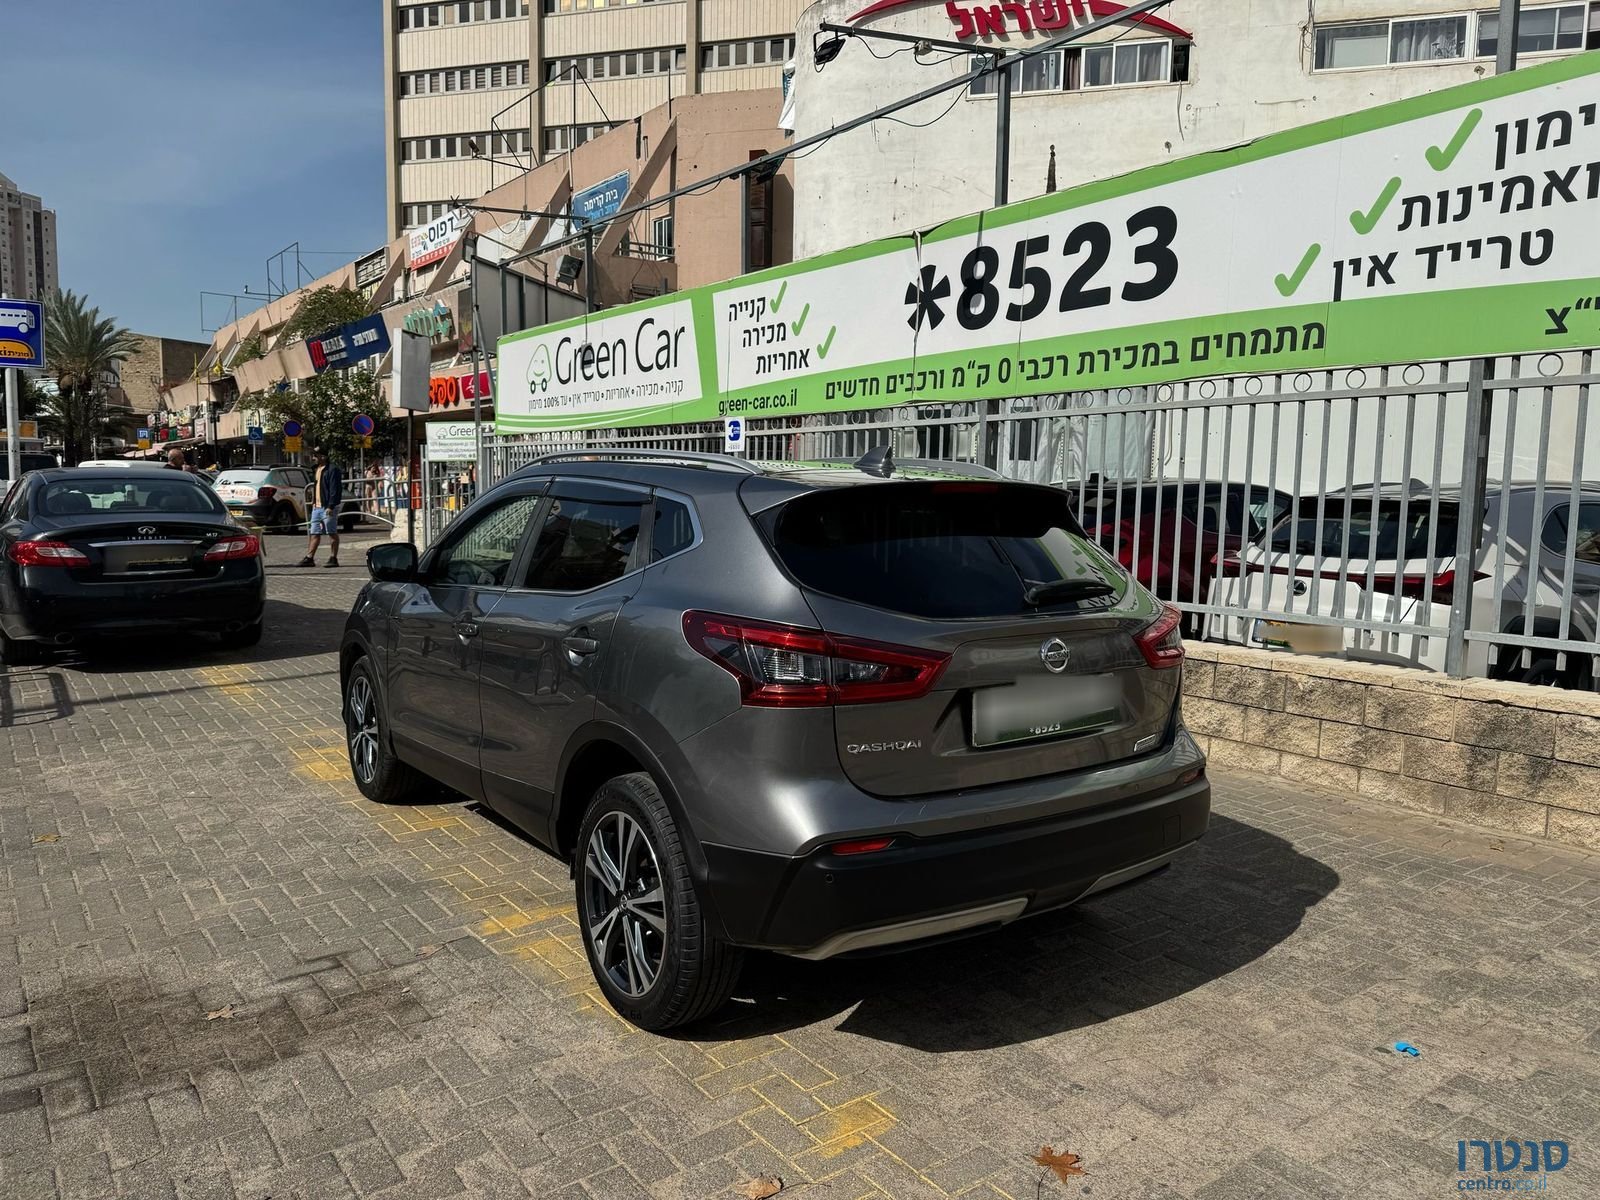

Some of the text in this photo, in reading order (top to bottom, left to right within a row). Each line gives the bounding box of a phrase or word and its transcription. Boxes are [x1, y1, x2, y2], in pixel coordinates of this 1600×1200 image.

[584, 194, 604, 212] קדימה
[605, 189, 618, 202] בית
[1333, 228, 1554, 302] טרייד אין
[728, 296, 766, 322] קנייה
[742, 322, 786, 348] מכירה
[1190, 322, 1325, 362] מתמחים
[556, 318, 685, 385] Green Car
[756, 348, 810, 374] אחריות
[1077, 340, 1180, 376] במכירת
[998, 357, 1012, 384] 0
[1018, 354, 1068, 381] רכבי
[826, 377, 880, 400] חדשים
[886, 370, 945, 394] ורכבים
[528, 380, 684, 413] קניה מכירה אחריות טרייד אין עד 100% מימון
[718, 389, 797, 416] green-car.co.il
[846, 740, 922, 754] QASHQAI
